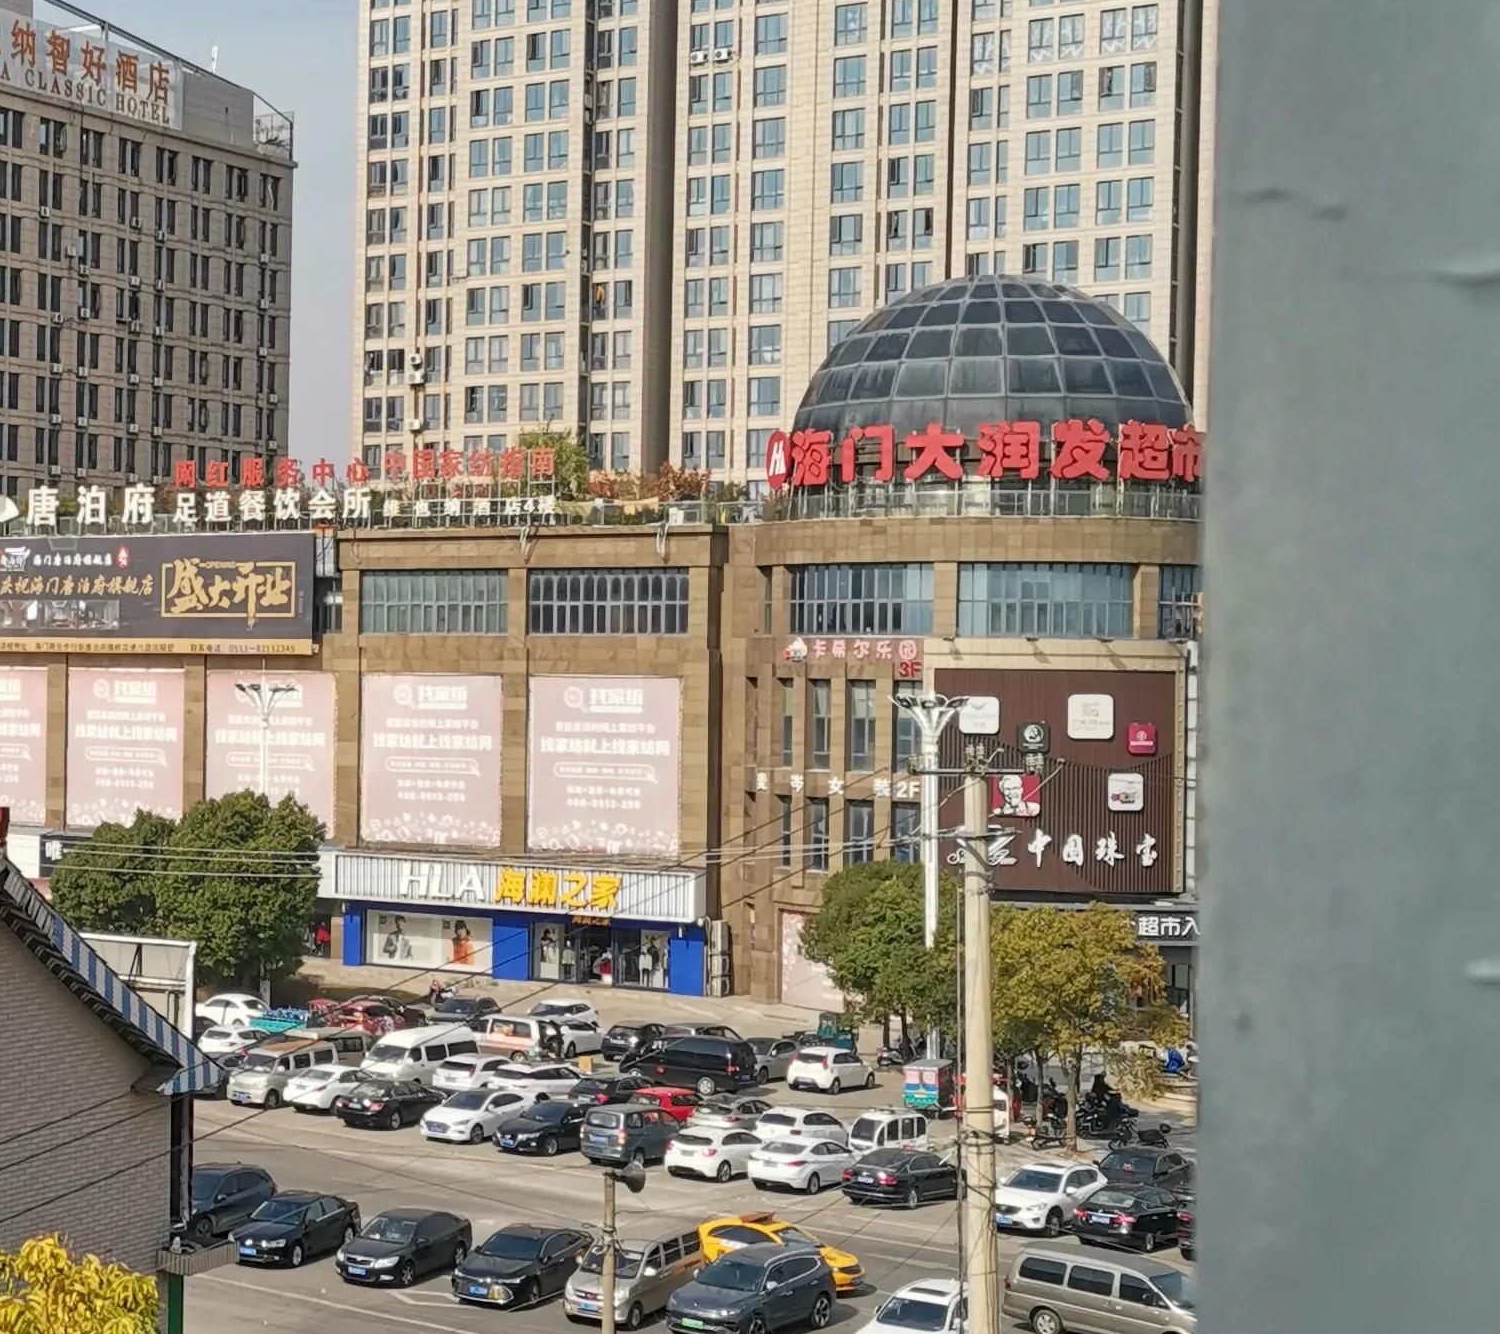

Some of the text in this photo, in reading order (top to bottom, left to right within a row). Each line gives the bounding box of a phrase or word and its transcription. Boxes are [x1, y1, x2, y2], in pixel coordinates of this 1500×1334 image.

[24, 68, 108, 107] CLASSIC
[114, 92, 171, 125] HOTEL
[792, 418, 1206, 488] 海门大润发超市
[174, 457, 371, 489] 网红服务中心
[26, 483, 156, 526] 唐泊府
[173, 485, 372, 525] 足道餐饮会所
[166, 557, 294, 629] 盛大开业
[898, 661, 922, 678] 3F
[372, 732, 493, 752] 找家纺就上找家纺网
[540, 736, 671, 757] 找家纺就上找家纺网
[895, 780, 921, 799] 2F
[1027, 828, 1159, 868] 中国珠宝
[400, 862, 486, 901] HLA
[495, 866, 622, 911] 海澜之家
